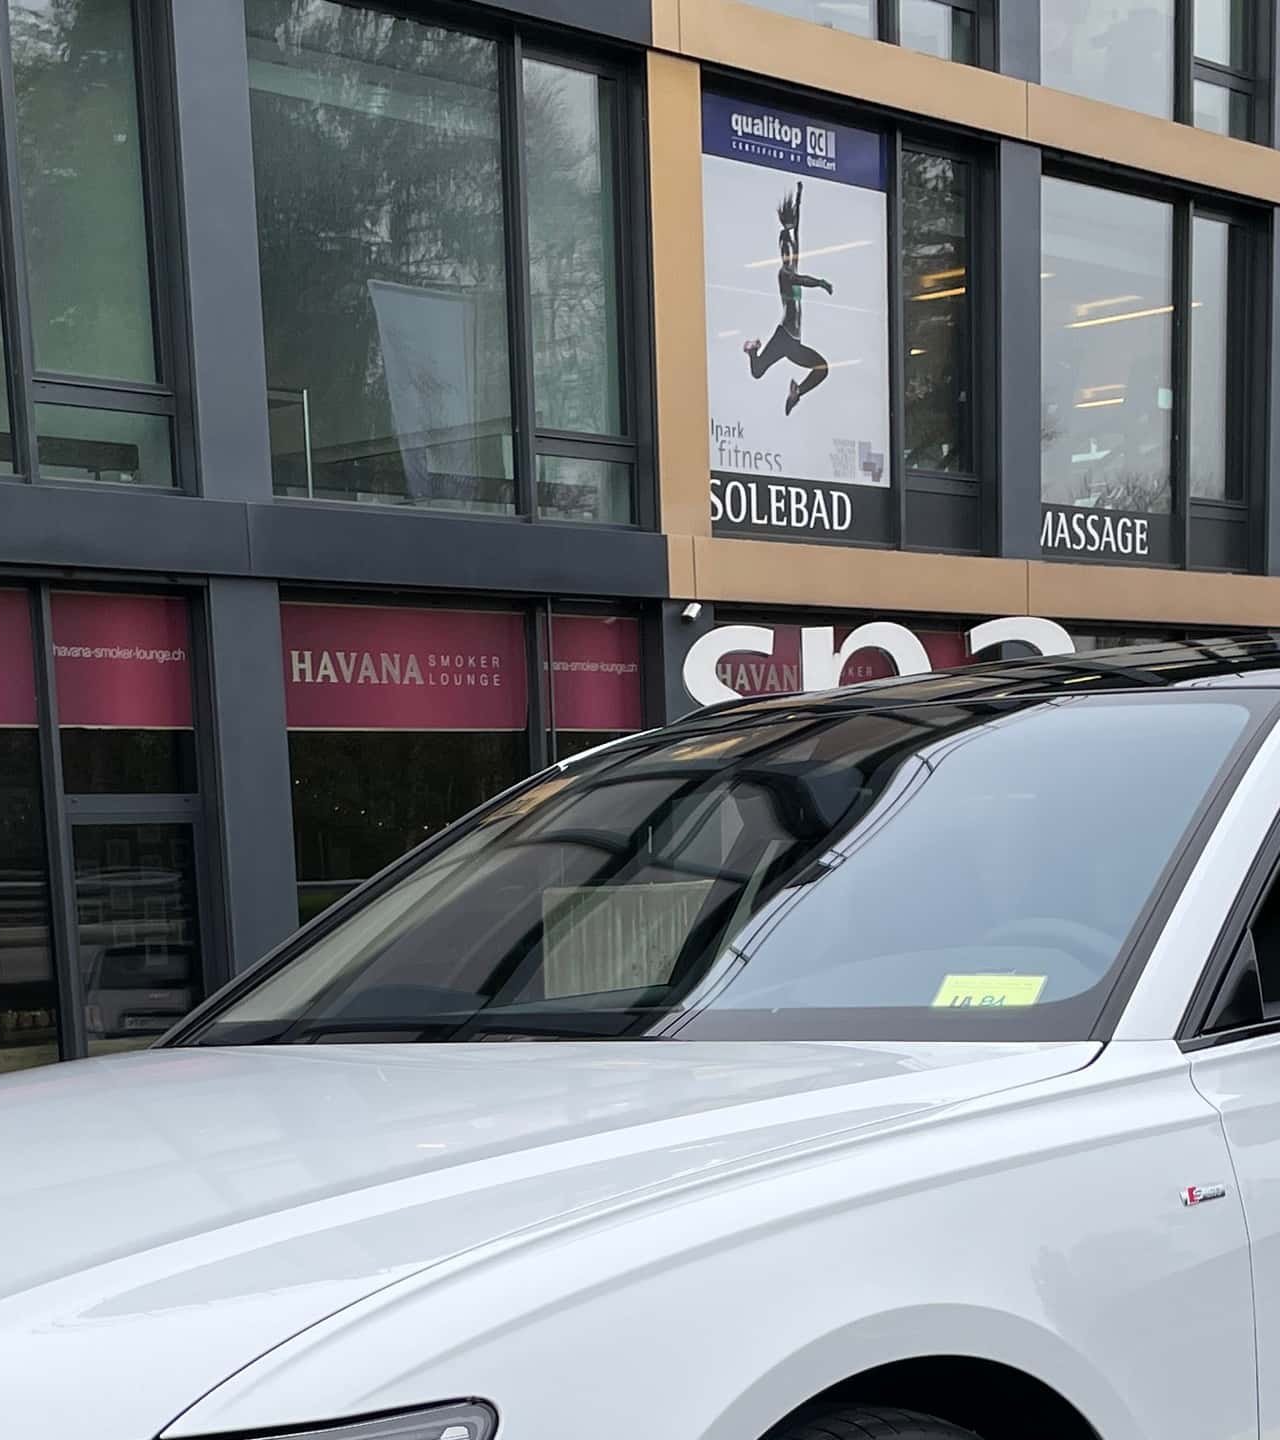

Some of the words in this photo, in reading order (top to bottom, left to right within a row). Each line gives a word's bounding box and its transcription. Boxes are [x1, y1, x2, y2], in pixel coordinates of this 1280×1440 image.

[731, 113, 802, 148] qualitop
[718, 440, 783, 472] fitness
[709, 478, 852, 531] SOLEBAD
[52, 643, 186, 663] havana-smoker-lounge.ch
[291, 650, 425, 685] HAVANA
[428, 654, 501, 669] SMOKER
[428, 673, 502, 687] LOUNGE
[717, 663, 798, 692] HAVAN
